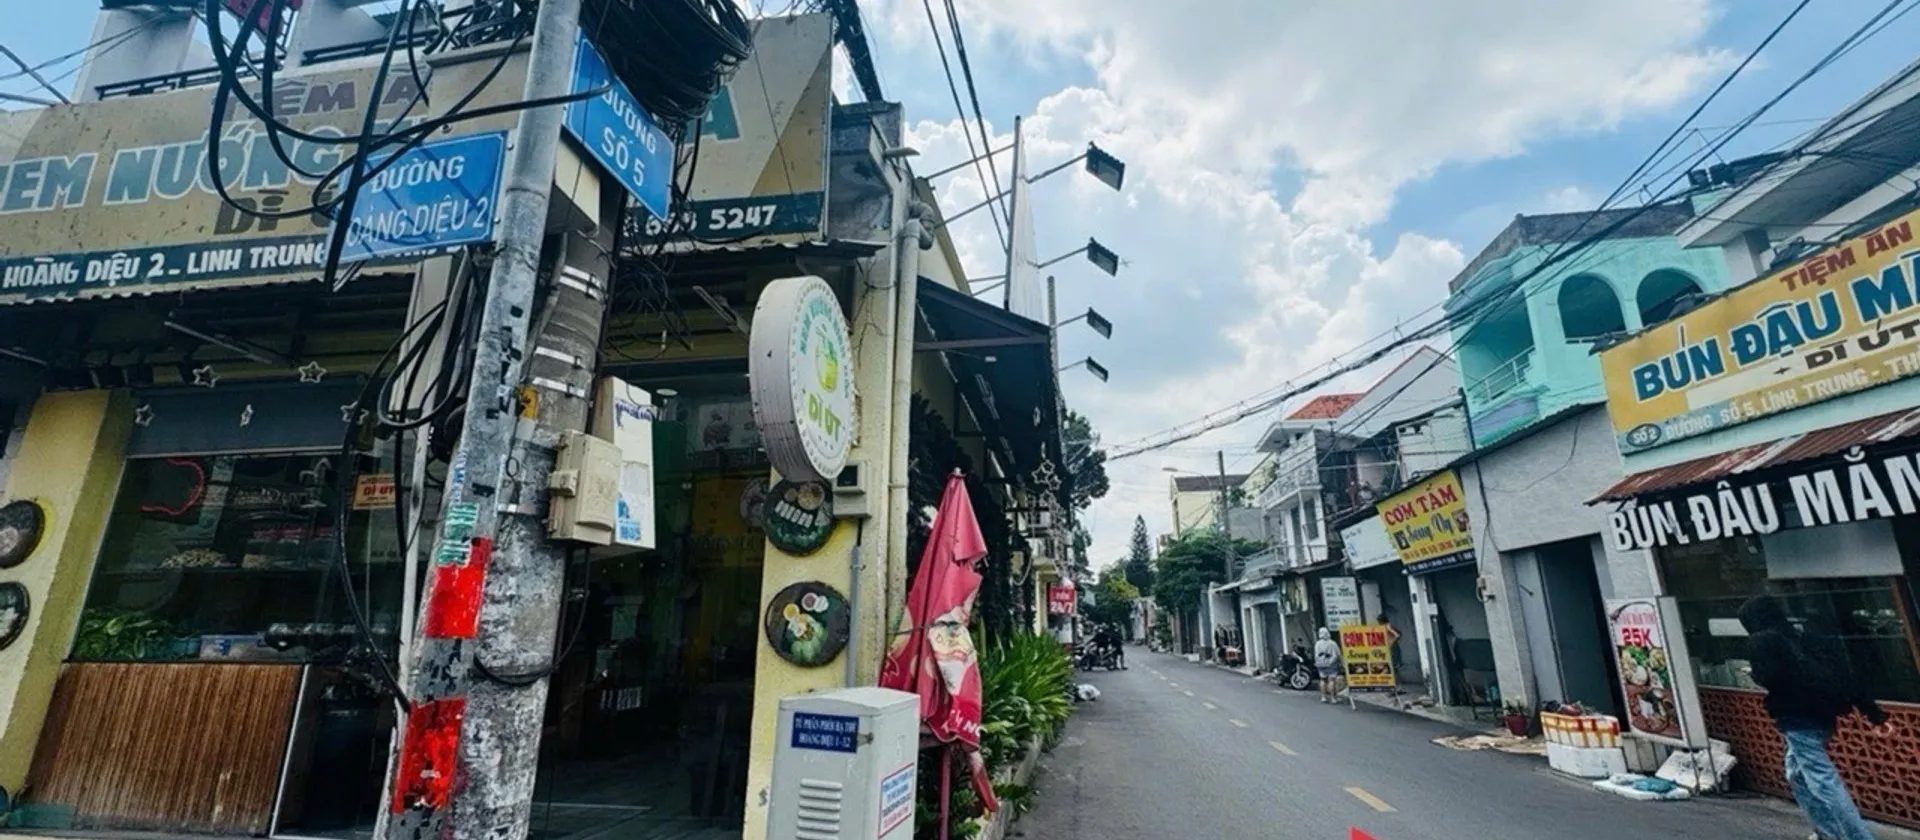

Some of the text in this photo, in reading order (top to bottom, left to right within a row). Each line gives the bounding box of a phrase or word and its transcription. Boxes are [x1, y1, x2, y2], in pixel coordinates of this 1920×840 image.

[601, 79, 656, 155] ĐƯỜNG
[104, 121, 350, 205] NƯỚNG
[371, 155, 466, 193] ĐƯỜNG
[601, 126, 645, 187] SỐ 5
[345, 205, 408, 247] OÀNG
[412, 195, 470, 240] DIỆU
[473, 197, 489, 228] 2
[708, 204, 777, 231] 5247
[3, 257, 79, 288] HOÀNG
[85, 252, 141, 287] DIỆU
[146, 252, 166, 279] 2
[187, 249, 242, 274] LINH
[1779, 220, 1913, 292] TIỆM ĂN
[1633, 249, 1920, 402] BÚN ĐẬU M
[1804, 318, 1920, 370] DÌ ÚT
[1665, 413, 1713, 439] ĐƯỜNG
[1719, 400, 1740, 423] SỐ
[1801, 367, 1870, 401] TRUNG
[1883, 345, 1920, 378] TH
[1648, 428, 1658, 440] 2
[1384, 482, 1458, 526] CƠM TẤM
[1608, 498, 1690, 551] BÚN
[1050, 601, 1073, 614] 24/7
[1343, 627, 1386, 647] CƠM TẤM
[1621, 627, 1654, 648] 25K
